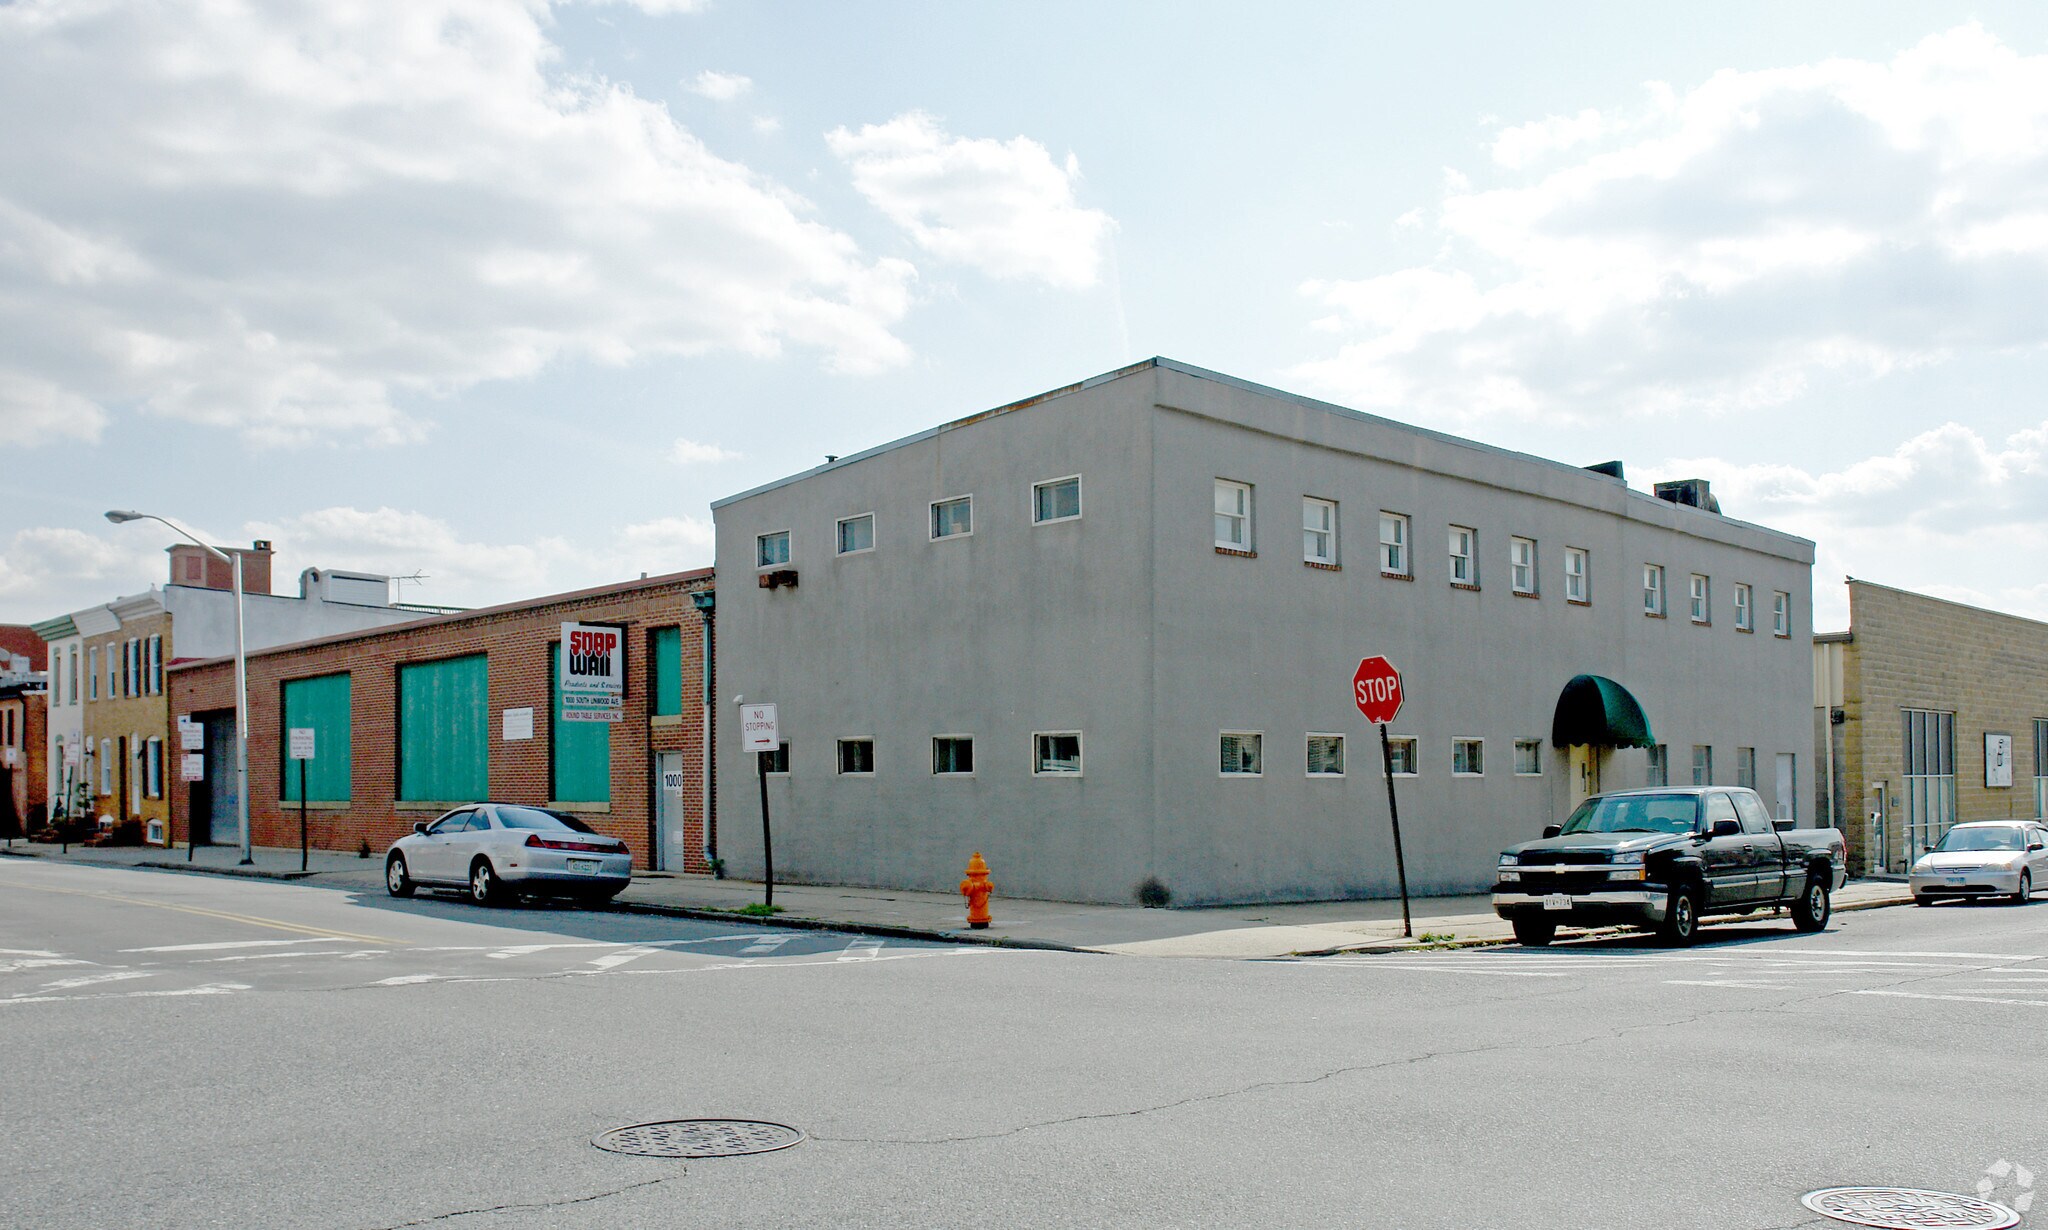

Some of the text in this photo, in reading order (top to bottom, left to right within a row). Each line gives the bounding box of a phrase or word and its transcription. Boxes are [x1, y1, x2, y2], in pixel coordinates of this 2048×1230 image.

[1356, 675, 1397, 705] STOP
[576, 696, 590, 704] SOUTH
[753, 710, 764, 719] NO
[745, 721, 775, 731] STOPPING
[665, 774, 682, 787] 1000
